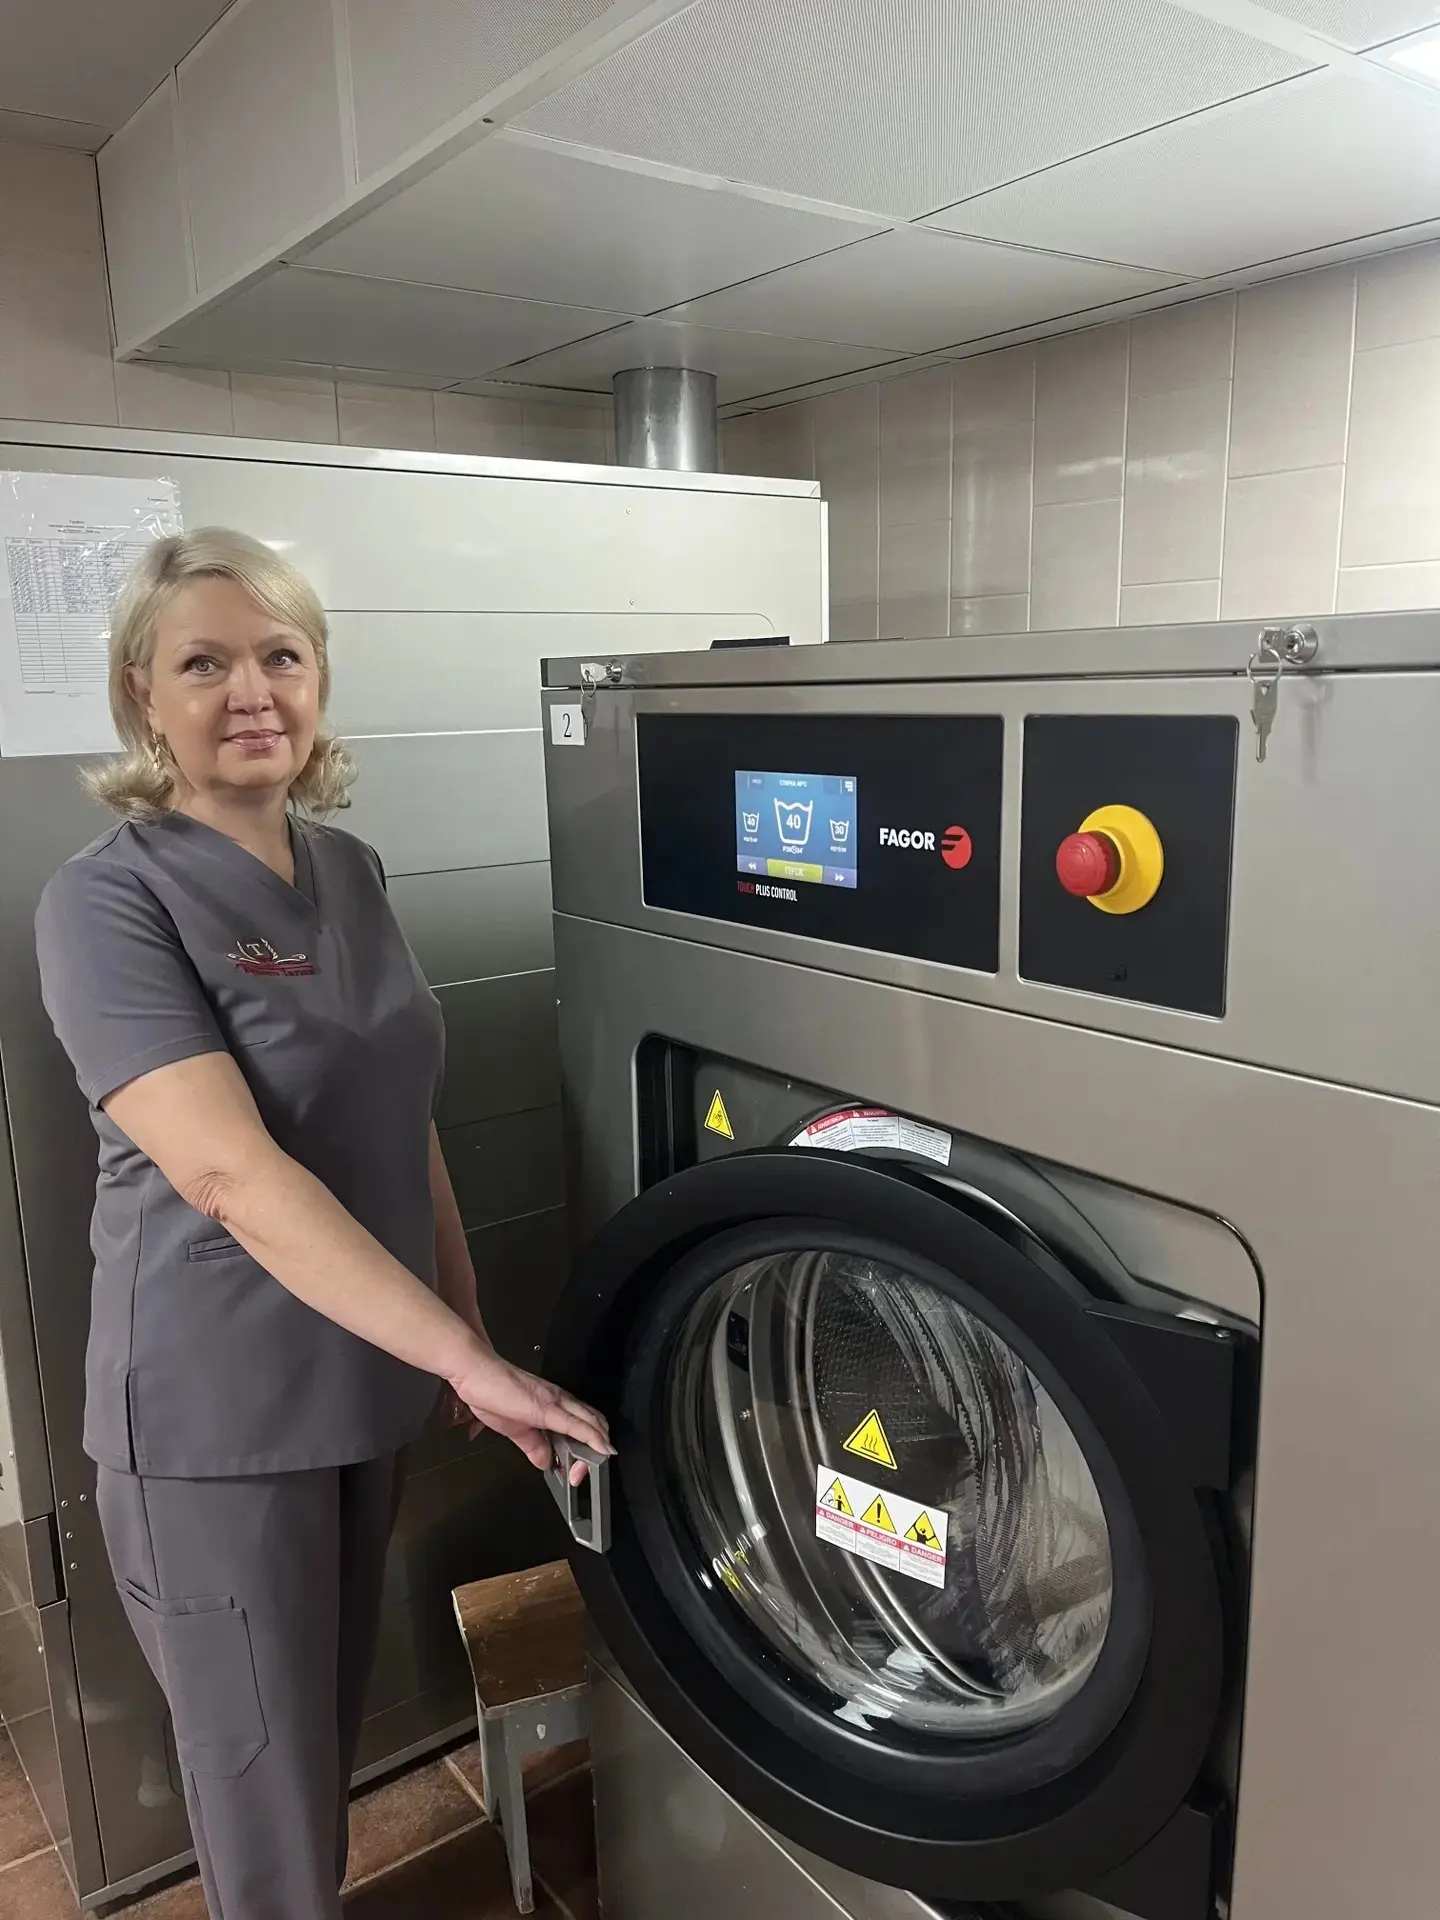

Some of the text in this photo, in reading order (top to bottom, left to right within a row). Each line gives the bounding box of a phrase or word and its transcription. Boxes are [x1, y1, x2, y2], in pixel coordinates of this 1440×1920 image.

[562, 712, 572, 738] 2
[786, 814, 801, 829] 40
[834, 826, 844, 835] 30
[879, 827, 936, 851] FAGOR
[737, 881, 798, 901] TOUCH PLUS CONTROL
[825, 1511, 854, 1529] DANGER
[865, 1529, 898, 1546] PELIGRO
[911, 1545, 943, 1563] DANGER
